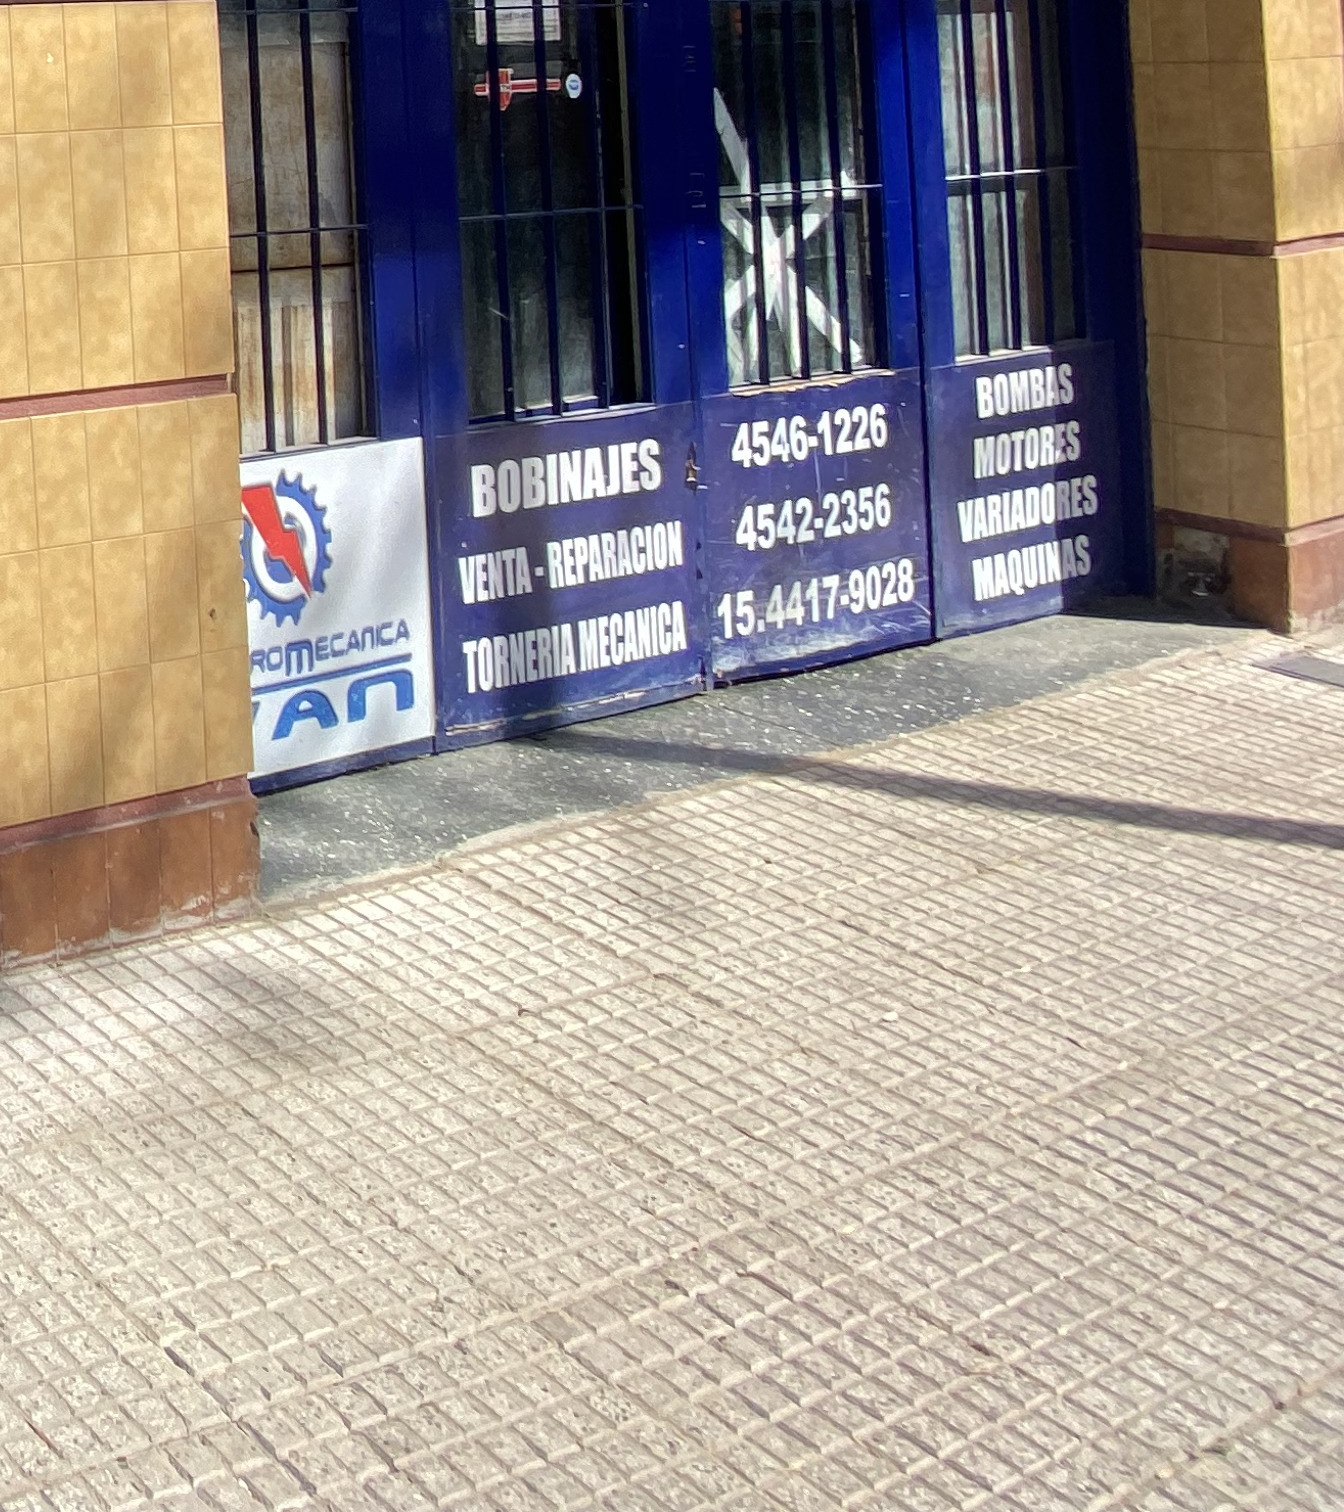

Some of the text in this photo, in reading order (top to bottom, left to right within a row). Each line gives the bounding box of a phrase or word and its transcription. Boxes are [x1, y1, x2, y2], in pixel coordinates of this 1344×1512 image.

[975, 362, 1075, 420] BOMBAS
[730, 403, 889, 469] 4546-1226
[973, 420, 1082, 480] MOTORES
[470, 438, 662, 518] BOBINAJES
[956, 474, 1099, 544] VARIADORES
[735, 483, 892, 551] 4542-2356
[458, 546, 534, 605] VENTA
[546, 520, 685, 589] REPARACION
[971, 535, 1093, 602] MAQUINAS
[716, 558, 916, 640] 15.4417-9028
[462, 600, 688, 694] TORNERIA MECANICA
